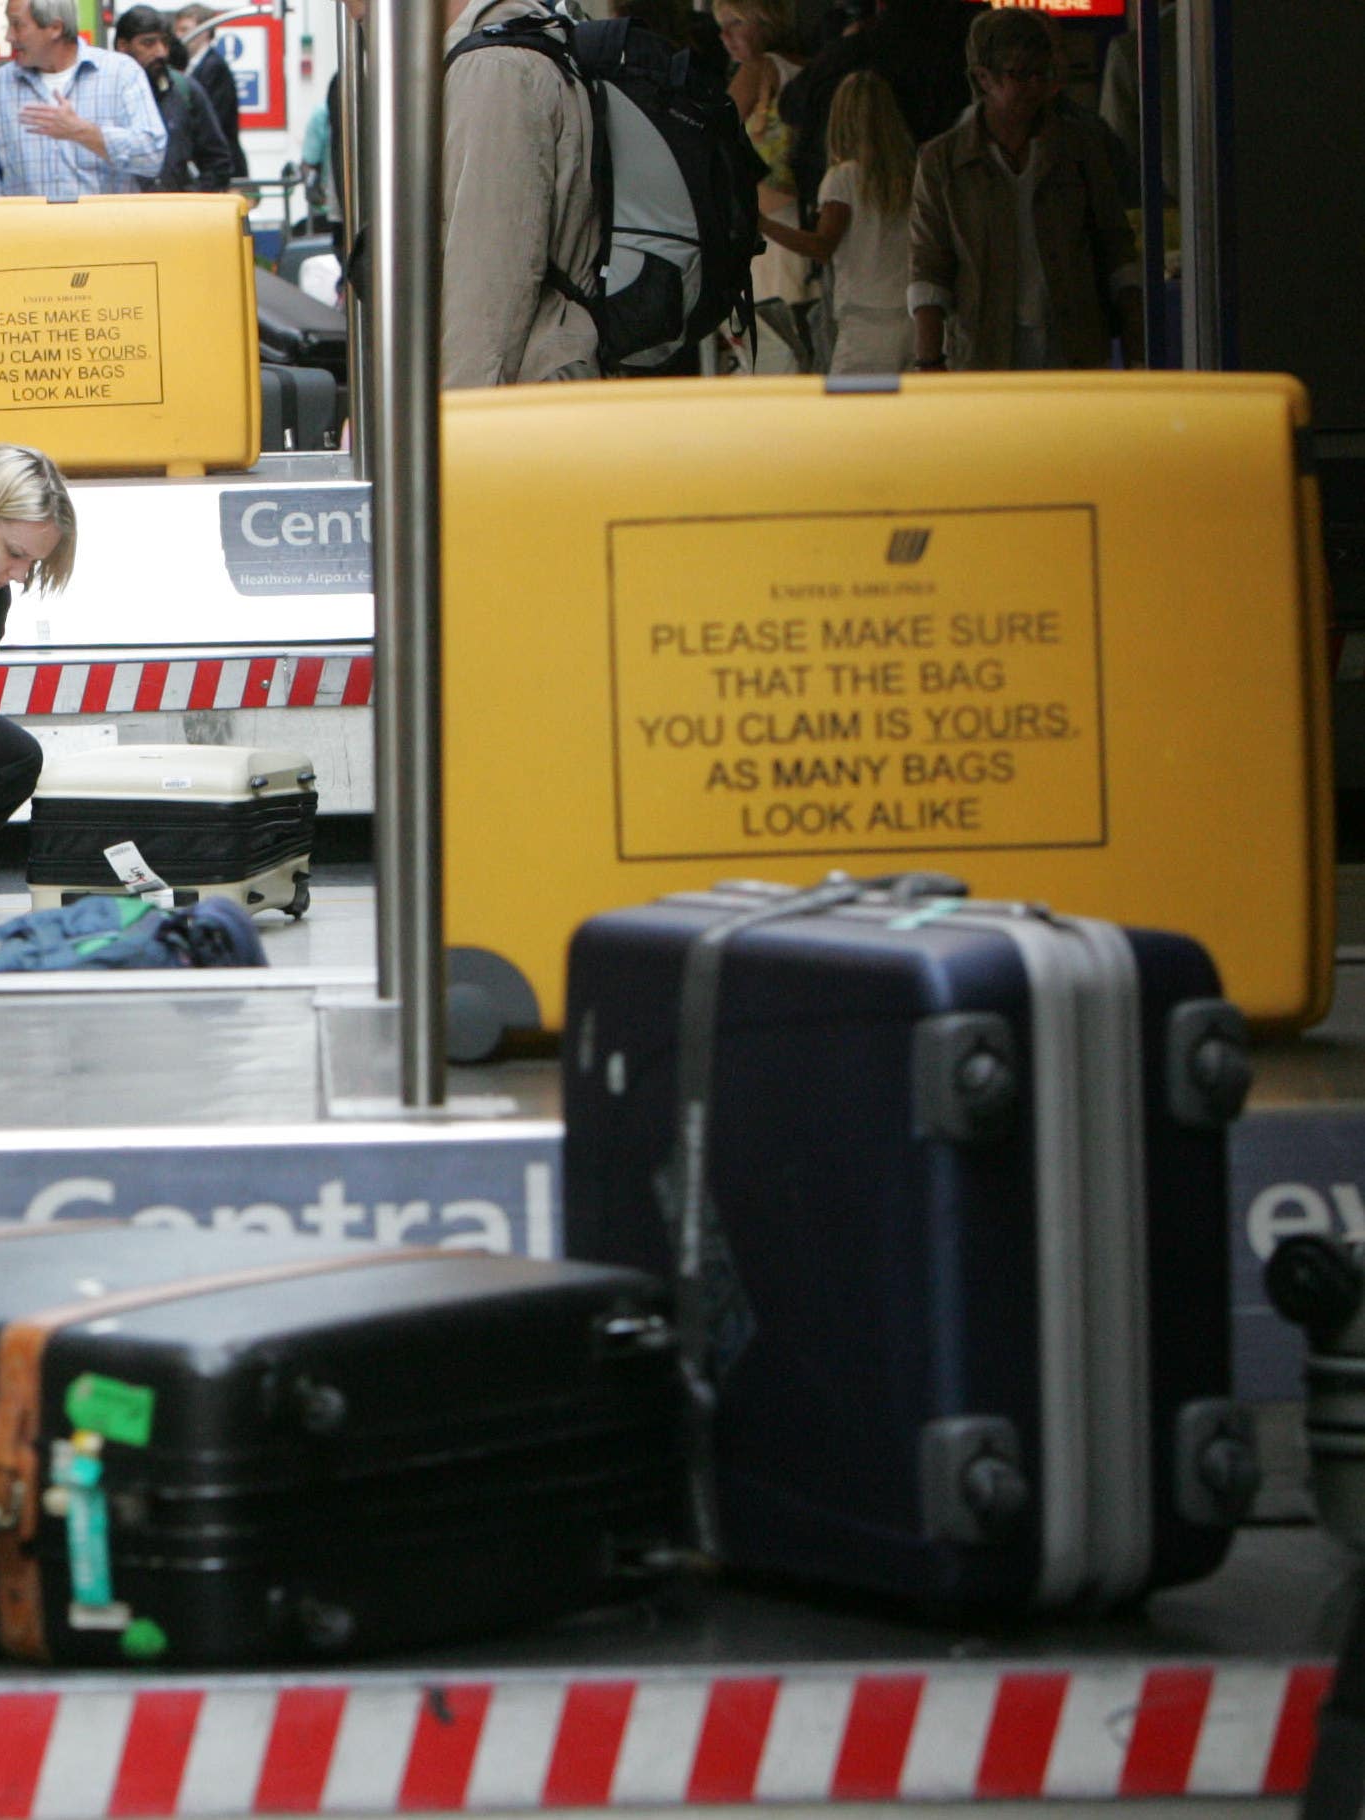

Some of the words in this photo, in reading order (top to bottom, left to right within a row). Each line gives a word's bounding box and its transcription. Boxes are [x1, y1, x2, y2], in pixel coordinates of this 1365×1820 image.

[44, 309, 91, 324] MAKE
[97, 306, 144, 321] SURE
[0, 330, 41, 345] THAT
[47, 329, 79, 343] THE
[85, 327, 121, 341] BAG
[10, 349, 61, 363] CLAIM
[67, 347, 82, 361] IS
[87, 344, 152, 361] YOURS.
[24, 366, 73, 381] MANY
[79, 365, 125, 379] BAGS
[12, 387, 59, 401] LOOK
[64, 384, 112, 399] ALIKE
[239, 573, 303, 585] Heathrow
[306, 572, 353, 586] Airport
[649, 621, 807, 657] PLEASE
[821, 615, 934, 652] MAKE
[949, 610, 1062, 647] SURE
[710, 666, 812, 701] THAT
[826, 662, 906, 697] THE
[919, 658, 1007, 693] BAG
[637, 714, 724, 749] YOU
[736, 711, 862, 746] CLAIM
[875, 708, 912, 741] IS
[925, 702, 1081, 742] YOURS.
[704, 759, 760, 793] AS
[771, 755, 889, 789] MANY
[902, 751, 1016, 786] BAGS
[740, 803, 855, 838] LOOK
[866, 797, 983, 832] ALIKE
